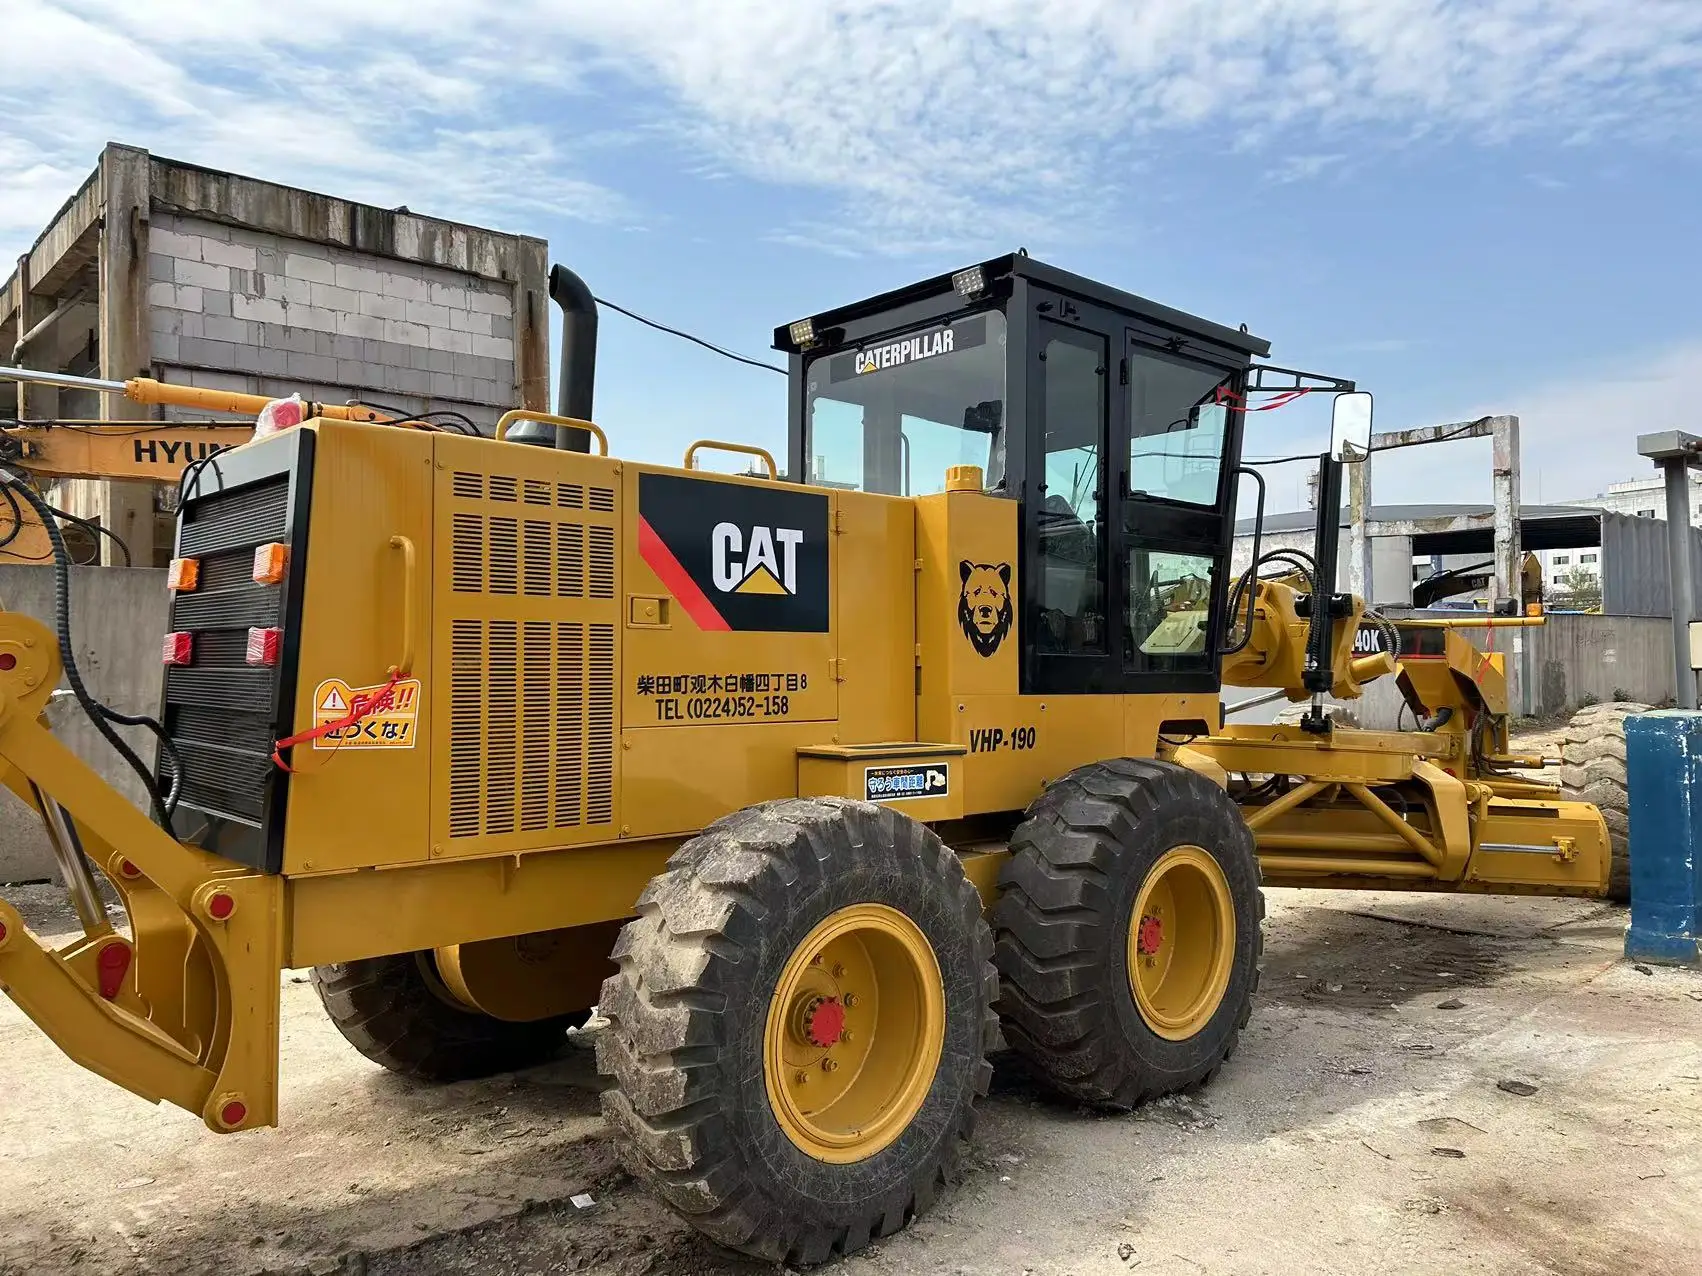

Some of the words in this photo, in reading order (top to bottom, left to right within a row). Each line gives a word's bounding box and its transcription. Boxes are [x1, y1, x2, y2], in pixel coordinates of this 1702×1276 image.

[855, 329, 954, 375] CATERPILLAR
[712, 522, 803, 595] CAT
[1471, 577, 1486, 589] CAT
[1352, 629, 1381, 652] 40K
[969, 726, 1036, 753] VHP-190
